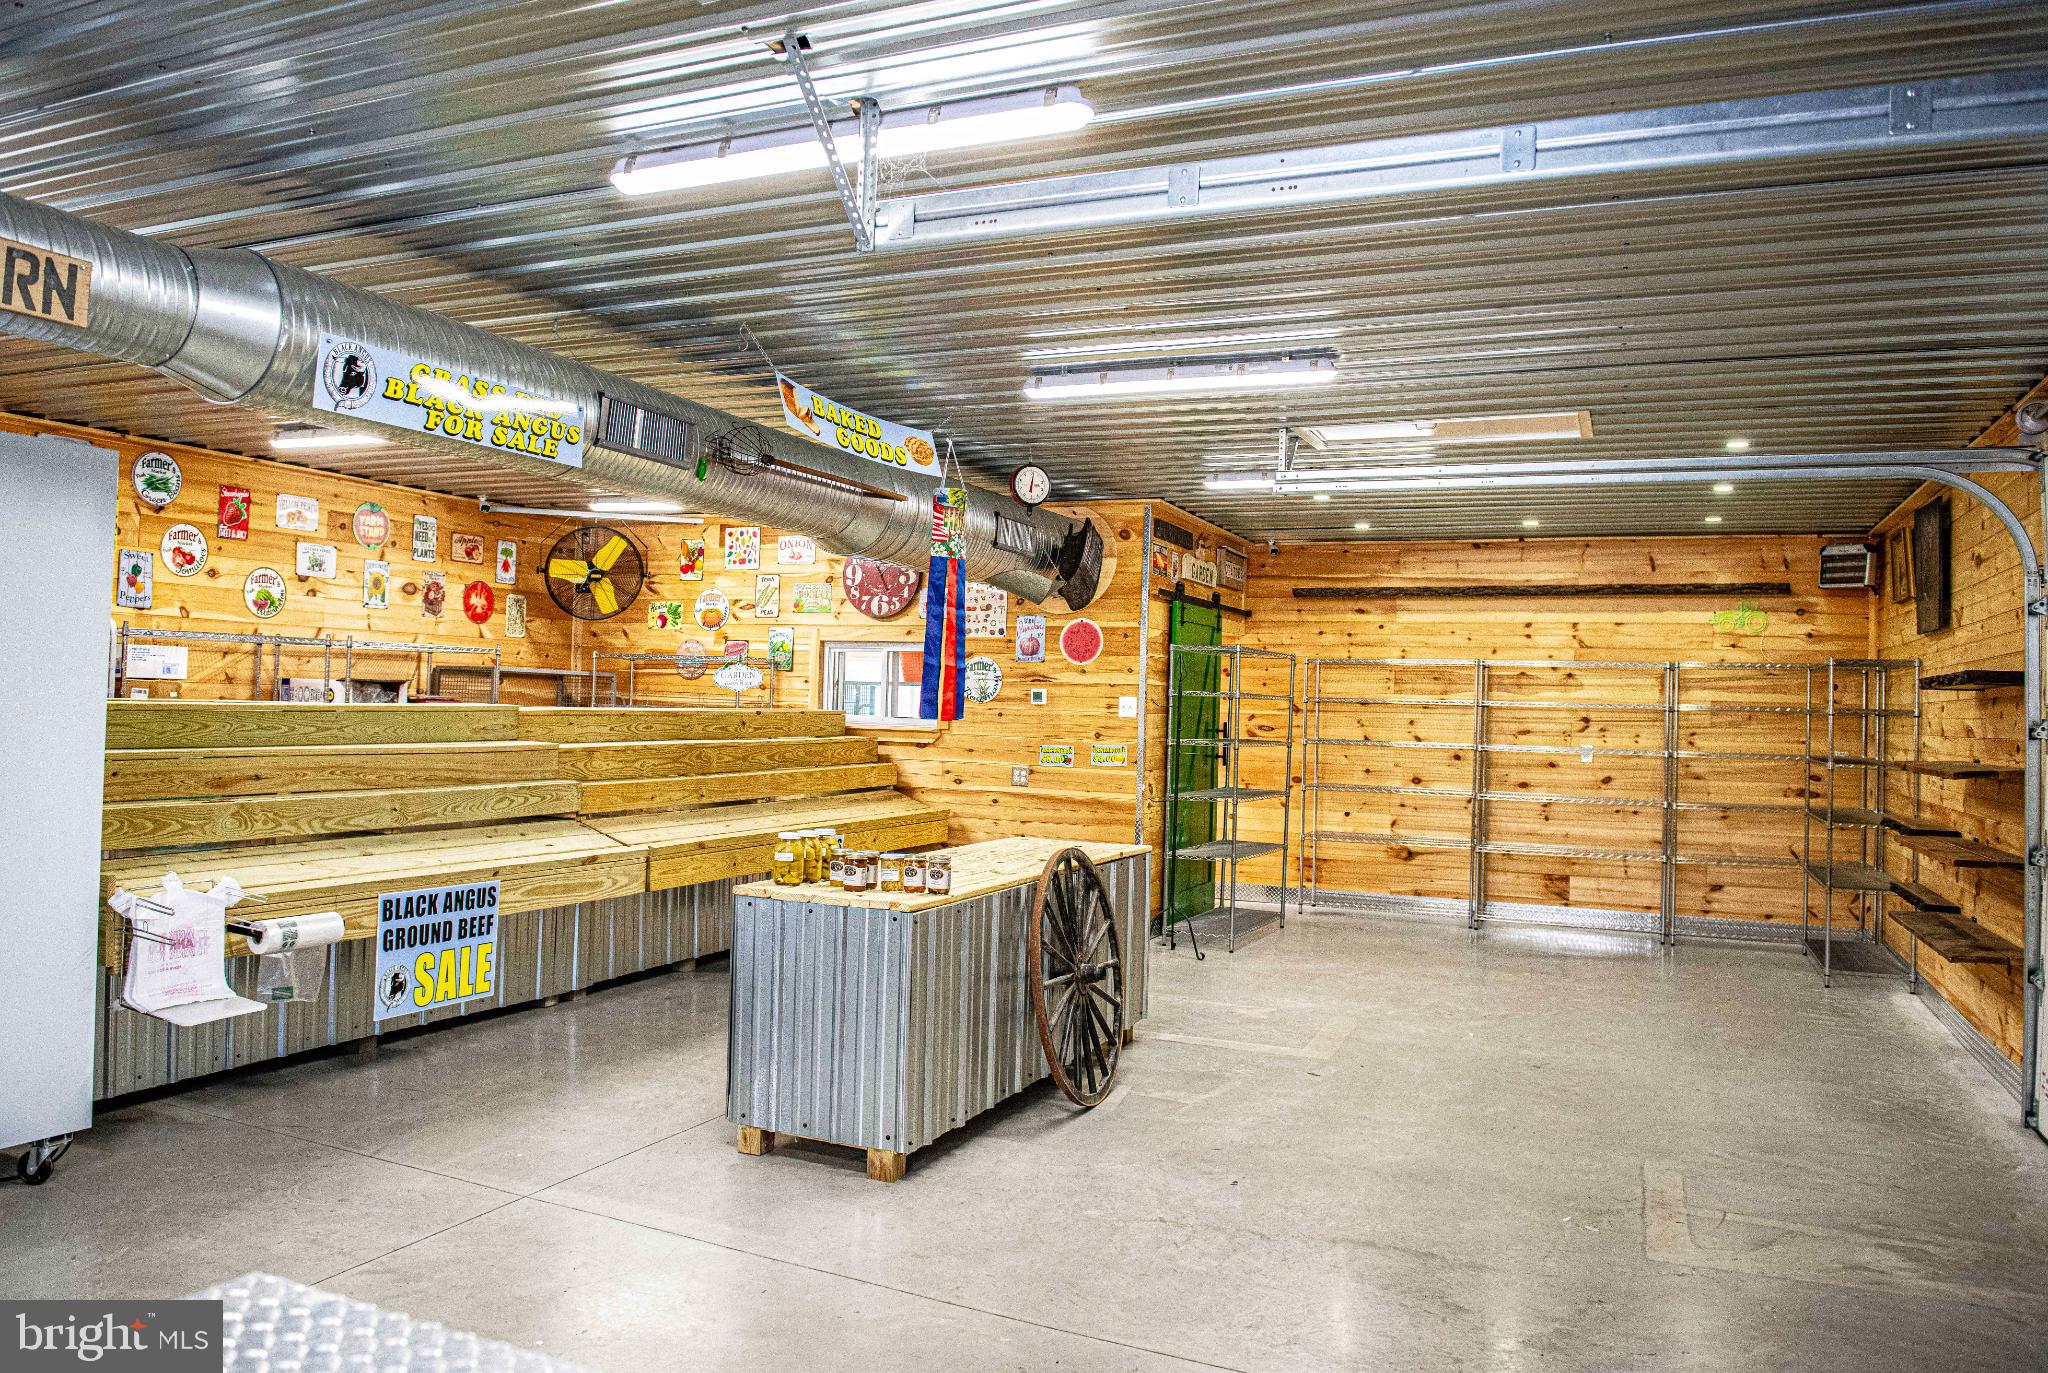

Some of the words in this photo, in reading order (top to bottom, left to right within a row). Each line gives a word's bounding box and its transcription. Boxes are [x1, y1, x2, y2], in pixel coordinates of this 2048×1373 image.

[491, 409, 581, 444] ANGUS
[811, 395, 881, 440] BAKED
[423, 410, 484, 441] FOR
[491, 427, 559, 459] SALE
[836, 427, 907, 466] GOODS
[359, 515, 385, 527] FARM
[359, 525, 385, 538] STAND
[412, 547, 435, 559] PLANTS
[780, 539, 813, 551] ONION
[845, 564, 863, 587] 9
[119, 590, 151, 604] Peppers
[850, 586, 860, 600] 8
[861, 595, 872, 611] 7
[889, 596, 900, 611] 5
[870, 594, 890, 616] 6
[383, 892, 440, 922] BLACK
[442, 886, 497, 914] ANGUS
[383, 920, 453, 953] GROUND
[457, 914, 495, 940] BEEF
[413, 941, 493, 1007] SALE
